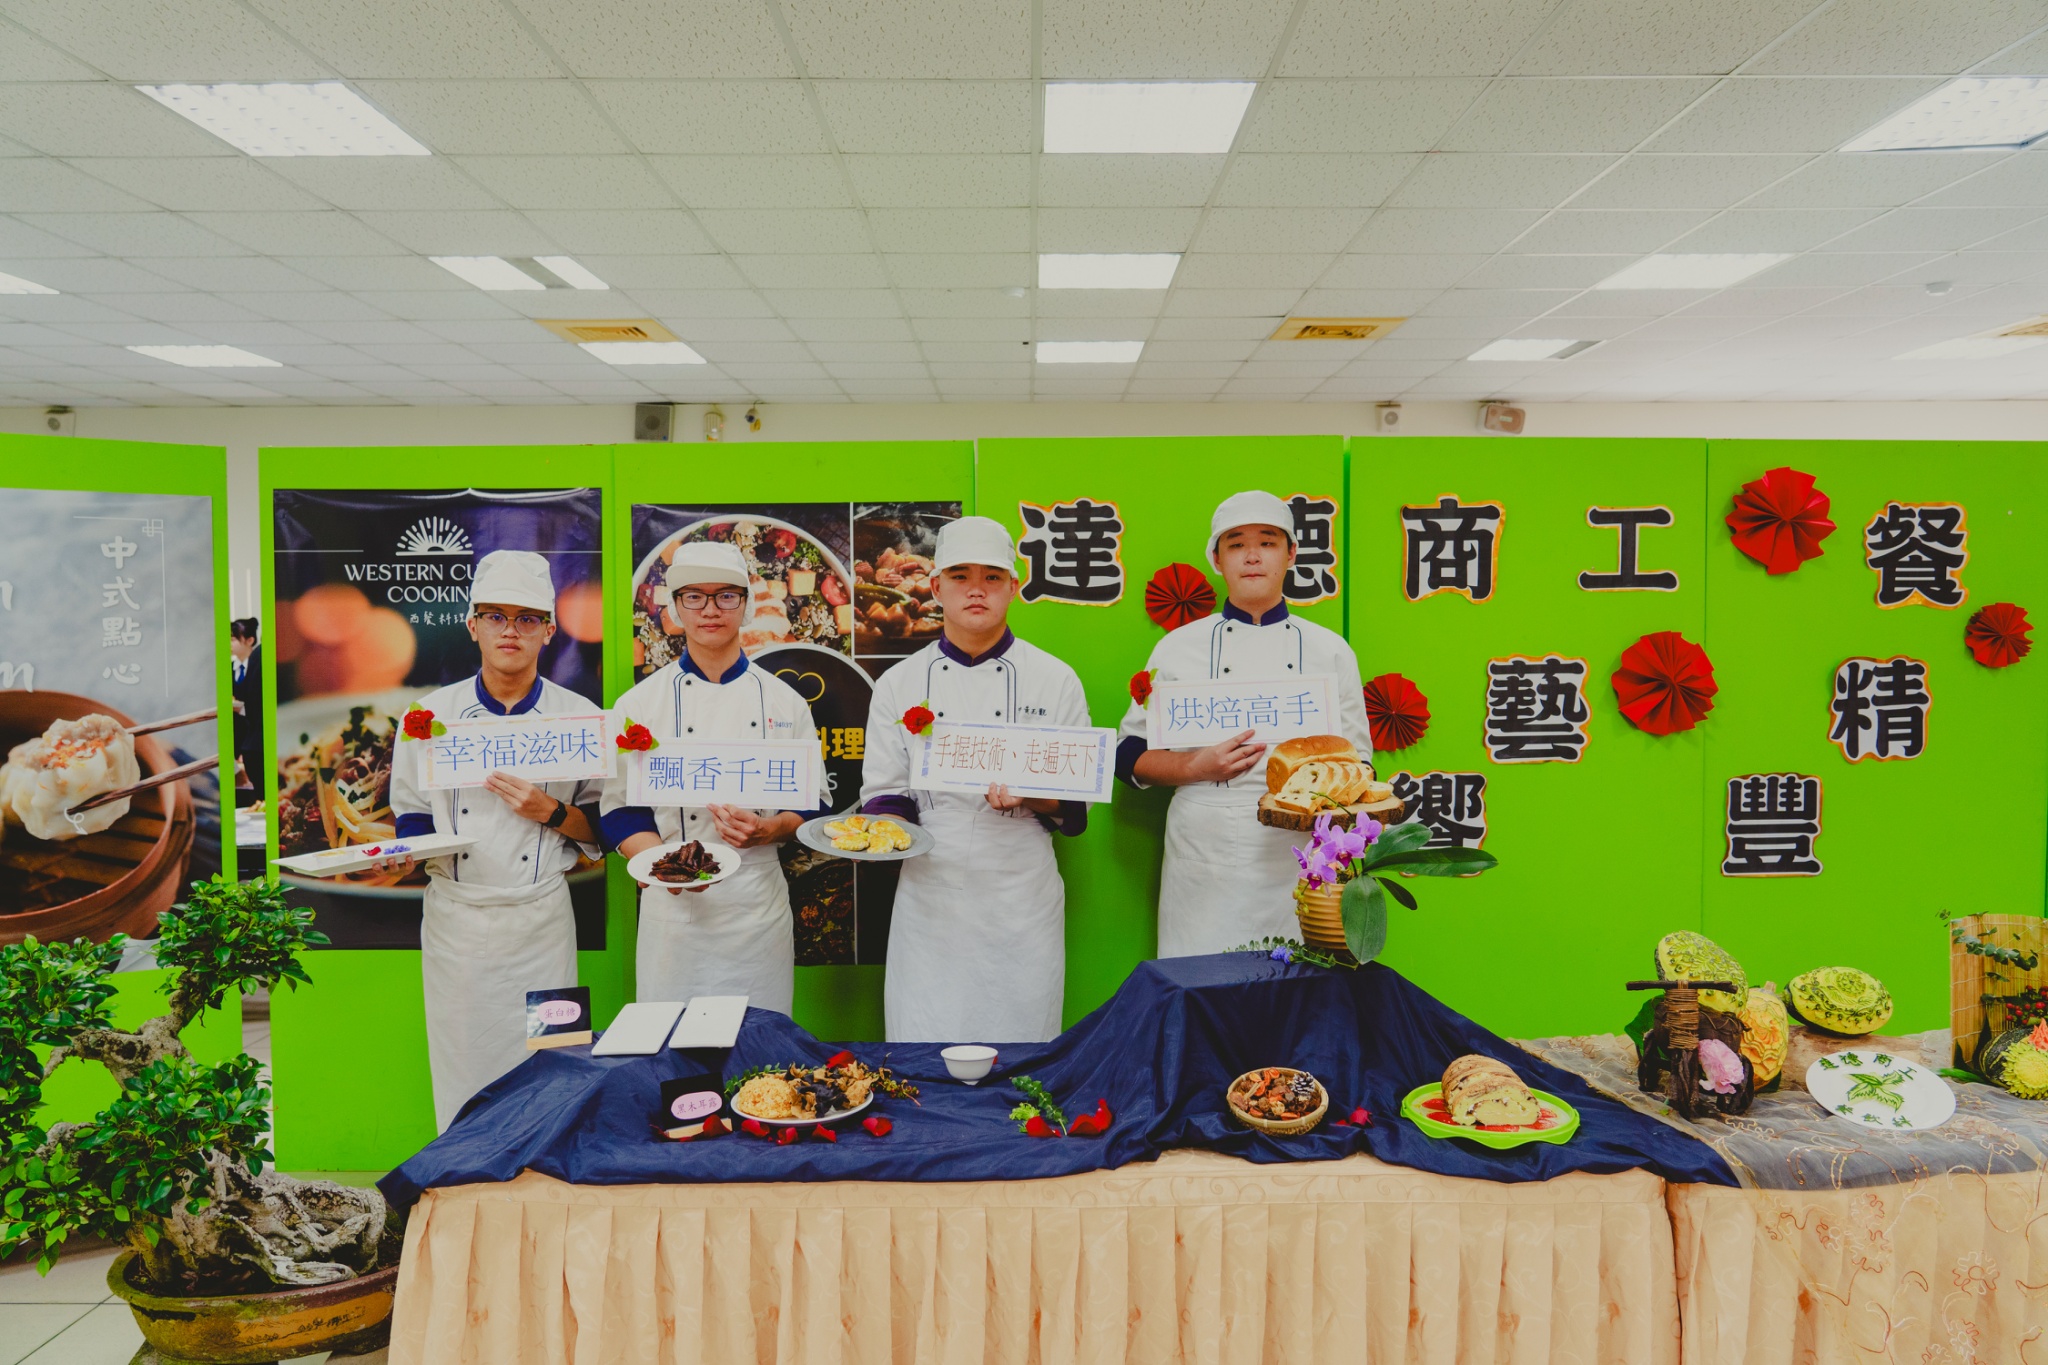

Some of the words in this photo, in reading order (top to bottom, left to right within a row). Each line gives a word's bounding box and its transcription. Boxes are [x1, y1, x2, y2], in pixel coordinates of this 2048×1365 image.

[344, 564, 443, 581] WESTERN
[450, 564, 478, 580] CU
[1867, 505, 1965, 604] 餐
[101, 535, 142, 685] 中式點心
[387, 586, 469, 603] COOKIN
[1167, 691, 1319, 732] 烘焙高手
[1487, 658, 1588, 760] 藝
[1833, 659, 1930, 758] 精
[434, 728, 599, 771] 幸福滋味
[934, 734, 1097, 778] 手握技術、走遍天下
[648, 756, 799, 793] 飄香千里
[1723, 777, 1822, 874] 豐
